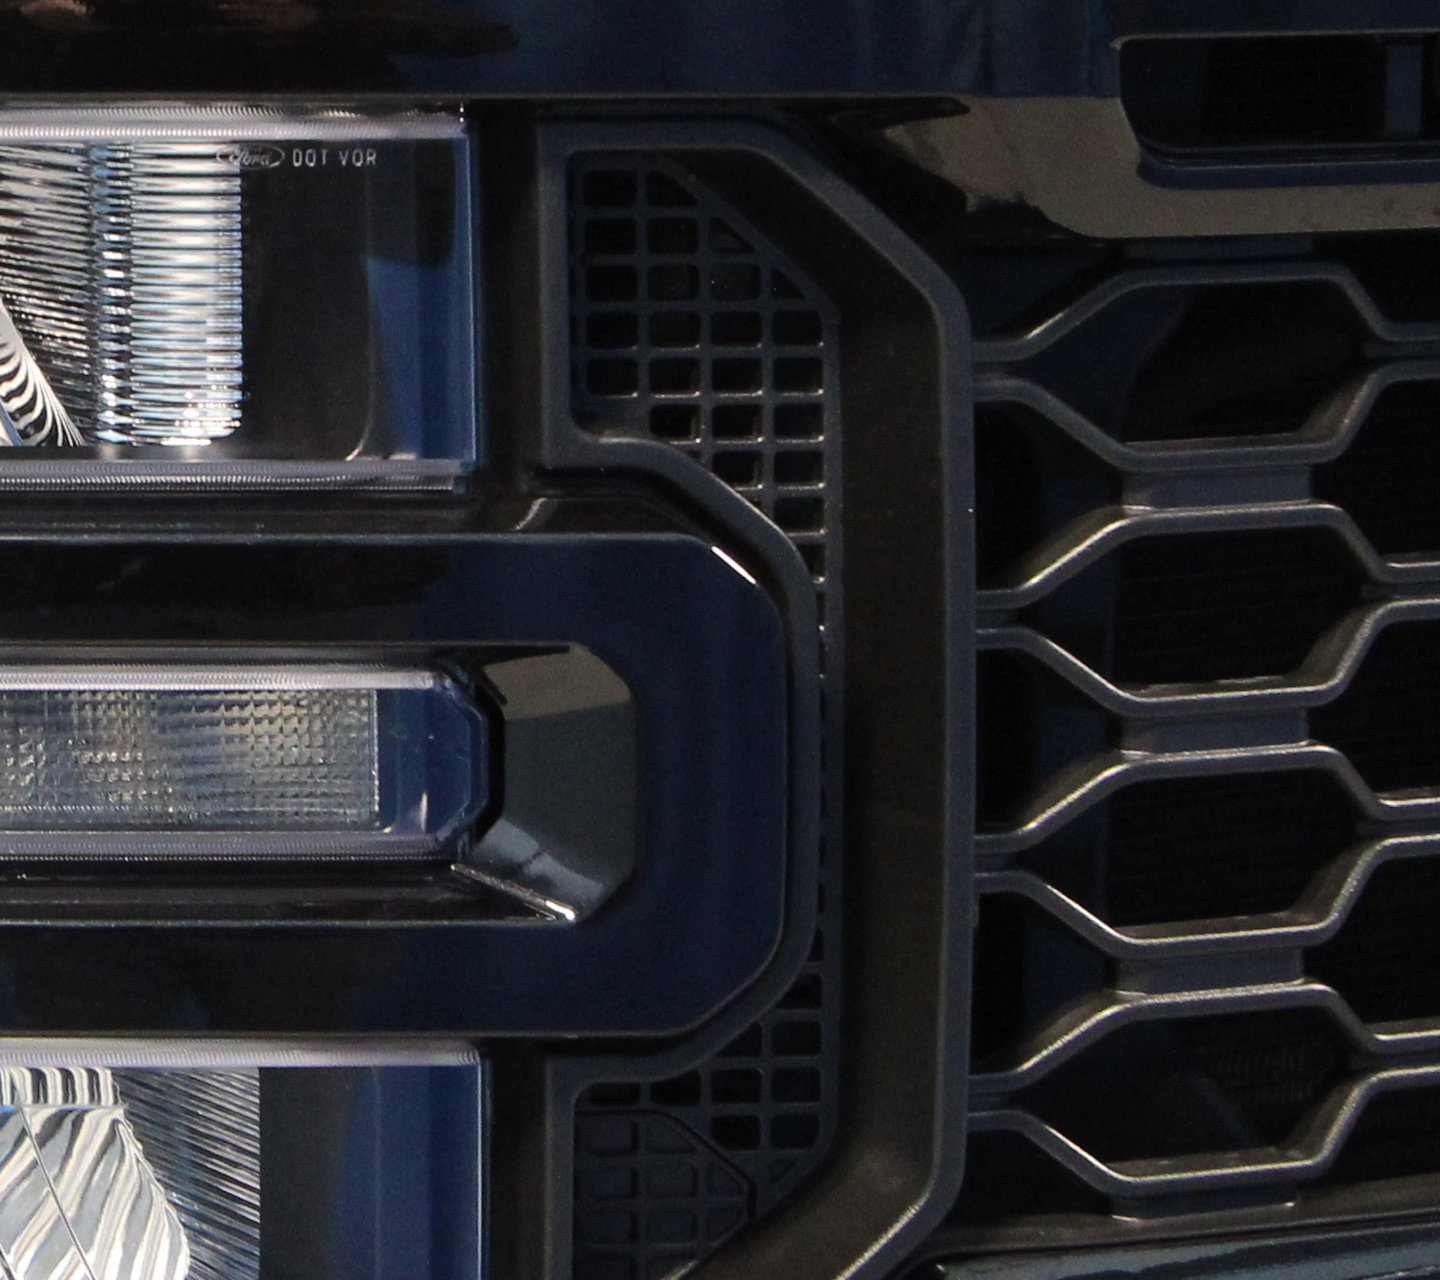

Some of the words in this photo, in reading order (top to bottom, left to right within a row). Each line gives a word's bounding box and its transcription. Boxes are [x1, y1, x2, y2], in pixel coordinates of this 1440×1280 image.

[226, 144, 275, 167] Ford
[292, 148, 329, 168] DOT
[338, 148, 378, 168] VOR
